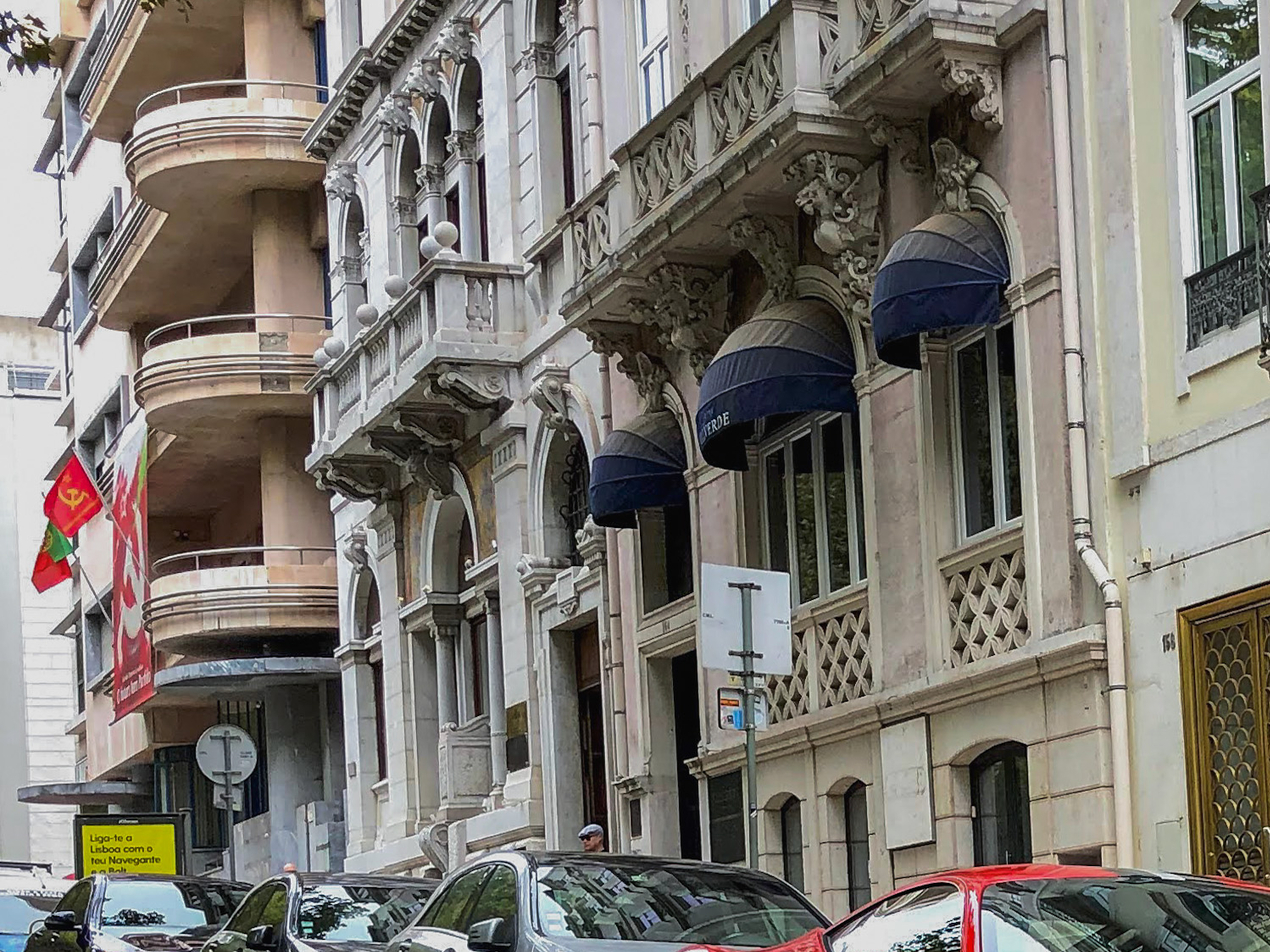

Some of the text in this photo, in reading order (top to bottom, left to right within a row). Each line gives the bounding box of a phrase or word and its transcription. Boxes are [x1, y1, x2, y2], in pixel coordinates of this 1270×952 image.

[89, 834, 124, 844] Liga-te
[90, 845, 121, 853] Lisboa
[91, 856, 161, 866] teu Navegante
